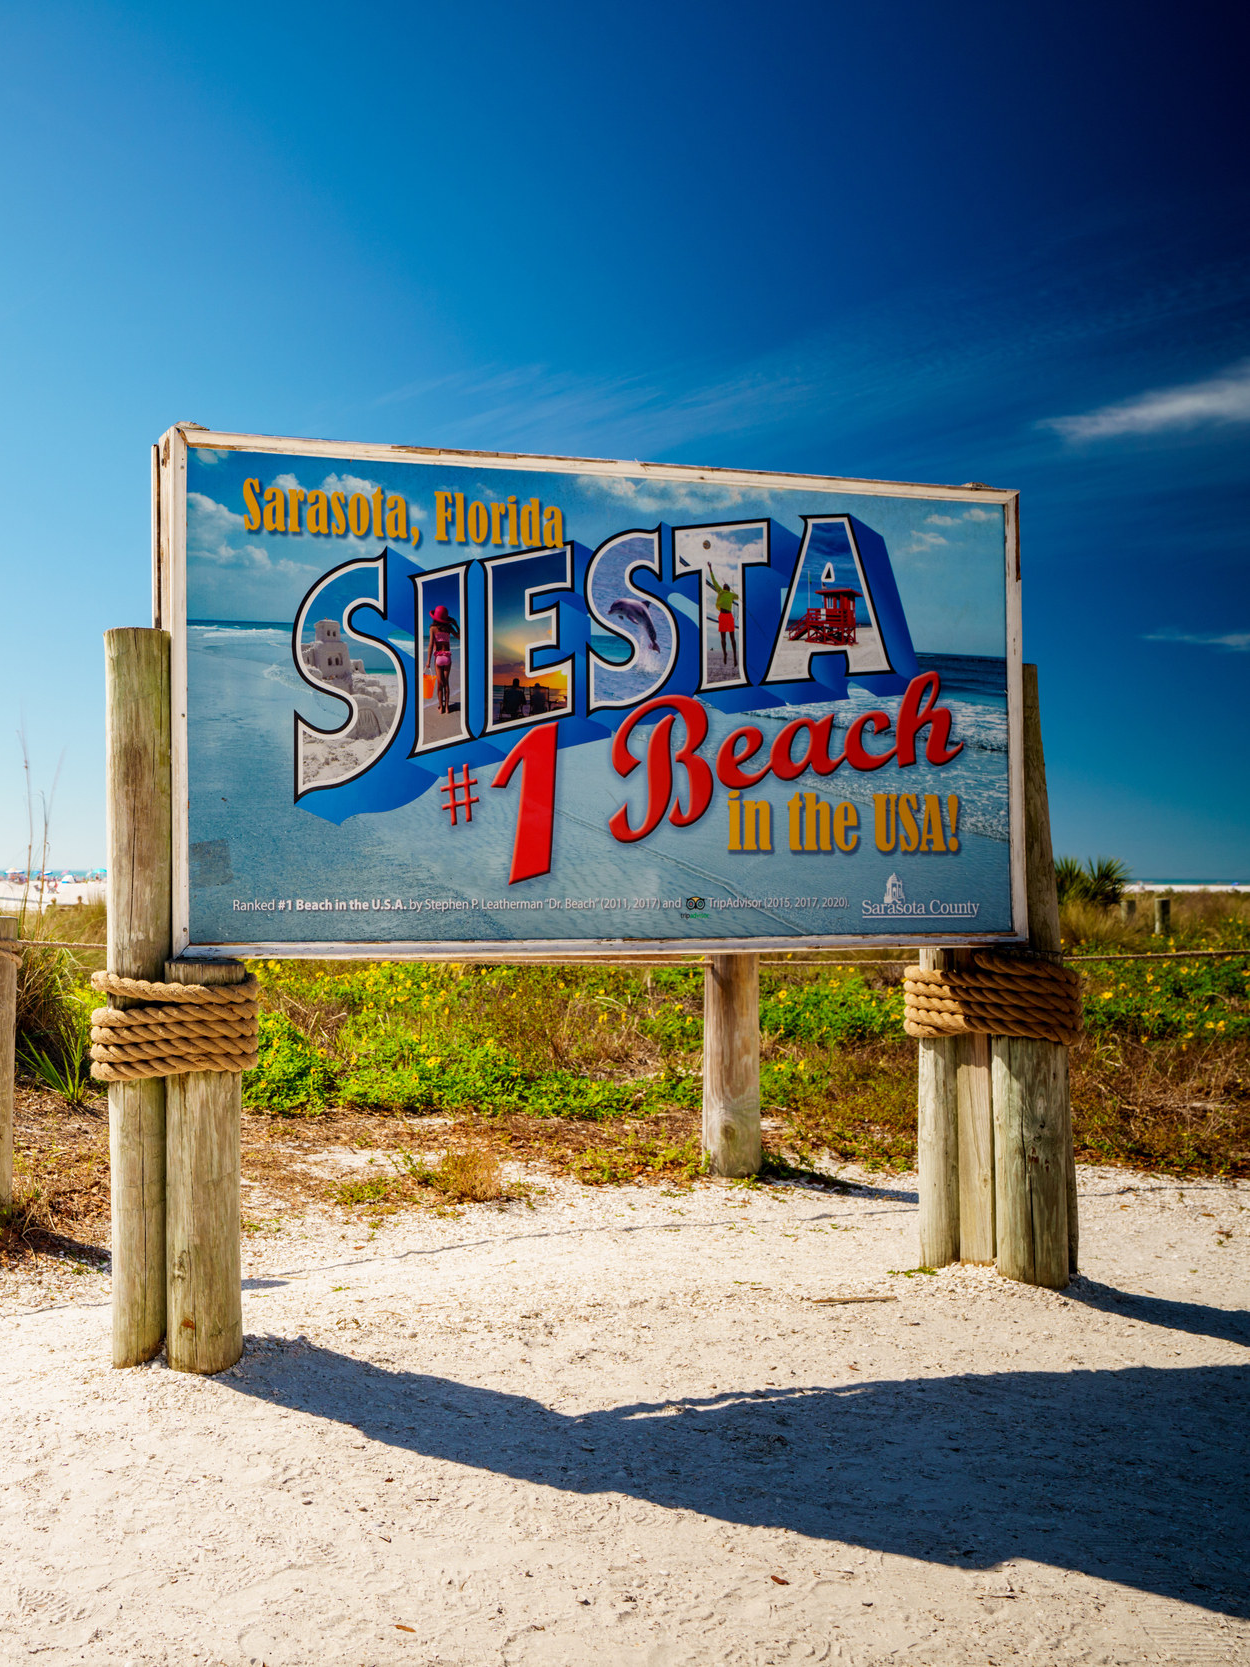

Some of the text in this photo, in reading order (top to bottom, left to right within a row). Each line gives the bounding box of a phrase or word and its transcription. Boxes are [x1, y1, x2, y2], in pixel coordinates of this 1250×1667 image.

[242, 477, 564, 549] Sarasota, Florida
[292, 513, 898, 812] SIESTA
[440, 671, 964, 886] #1 Beach
[727, 790, 960, 852] in the USA!
[232, 899, 275, 911] Ranked
[278, 899, 293, 911] #1
[295, 898, 331, 911] Beach
[335, 899, 347, 911] in
[349, 899, 369, 911] the
[371, 899, 407, 910] U.S.A.
[409, 898, 423, 912] by
[425, 898, 469, 912] Stephen
[471, 899, 480, 910] P.
[481, 898, 543, 910] Leatherman
[601, 898, 631, 911] (2011,
[633, 898, 660, 910] 2017)
[662, 897, 682, 909] and
[708, 897, 762, 911] TripAdvisor
[764, 897, 791, 909] (2015,
[794, 897, 821, 909] 2017,
[822, 897, 850, 908] 2020).
[861, 899, 980, 918] Sarasota County
